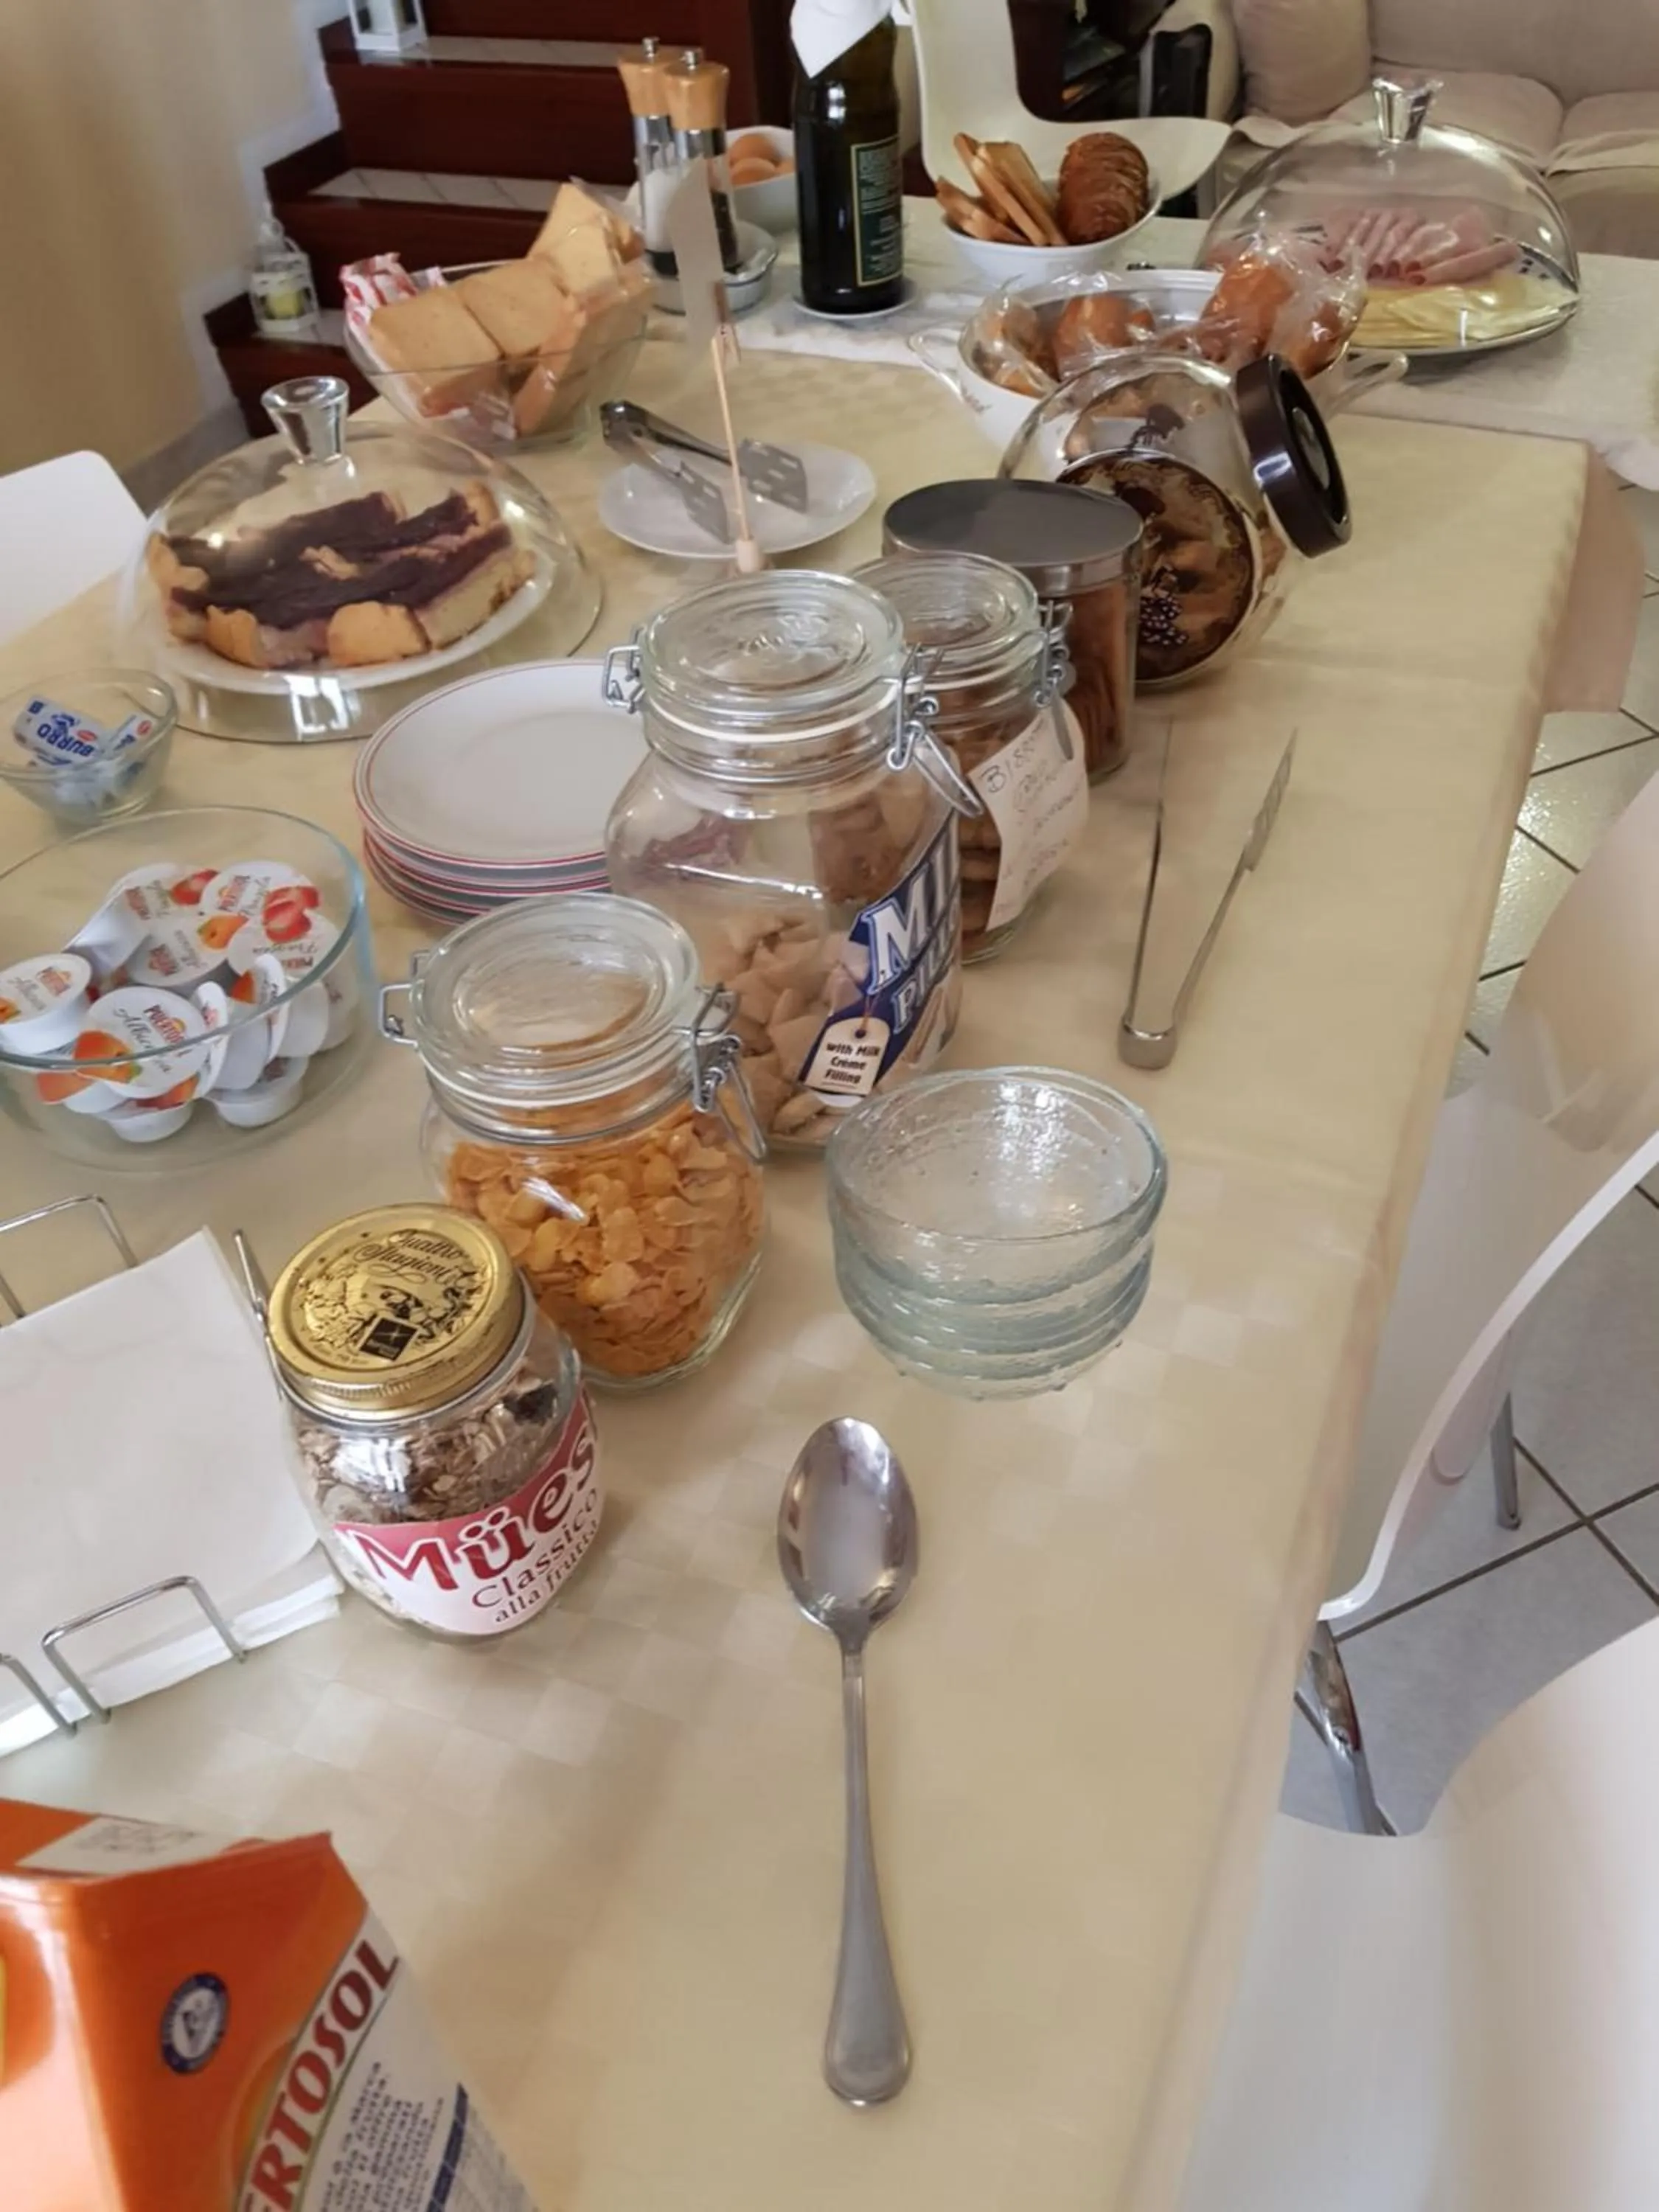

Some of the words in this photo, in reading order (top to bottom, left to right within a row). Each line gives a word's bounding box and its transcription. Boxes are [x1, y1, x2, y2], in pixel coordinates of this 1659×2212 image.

[37, 723, 95, 757] BURRO
[827, 1042, 852, 1055] with
[856, 1045, 880, 1057] Milk
[472, 1488, 597, 1608] Classico
[495, 1589, 541, 1623] alla
[243, 1940, 400, 2212] RTOSOL
